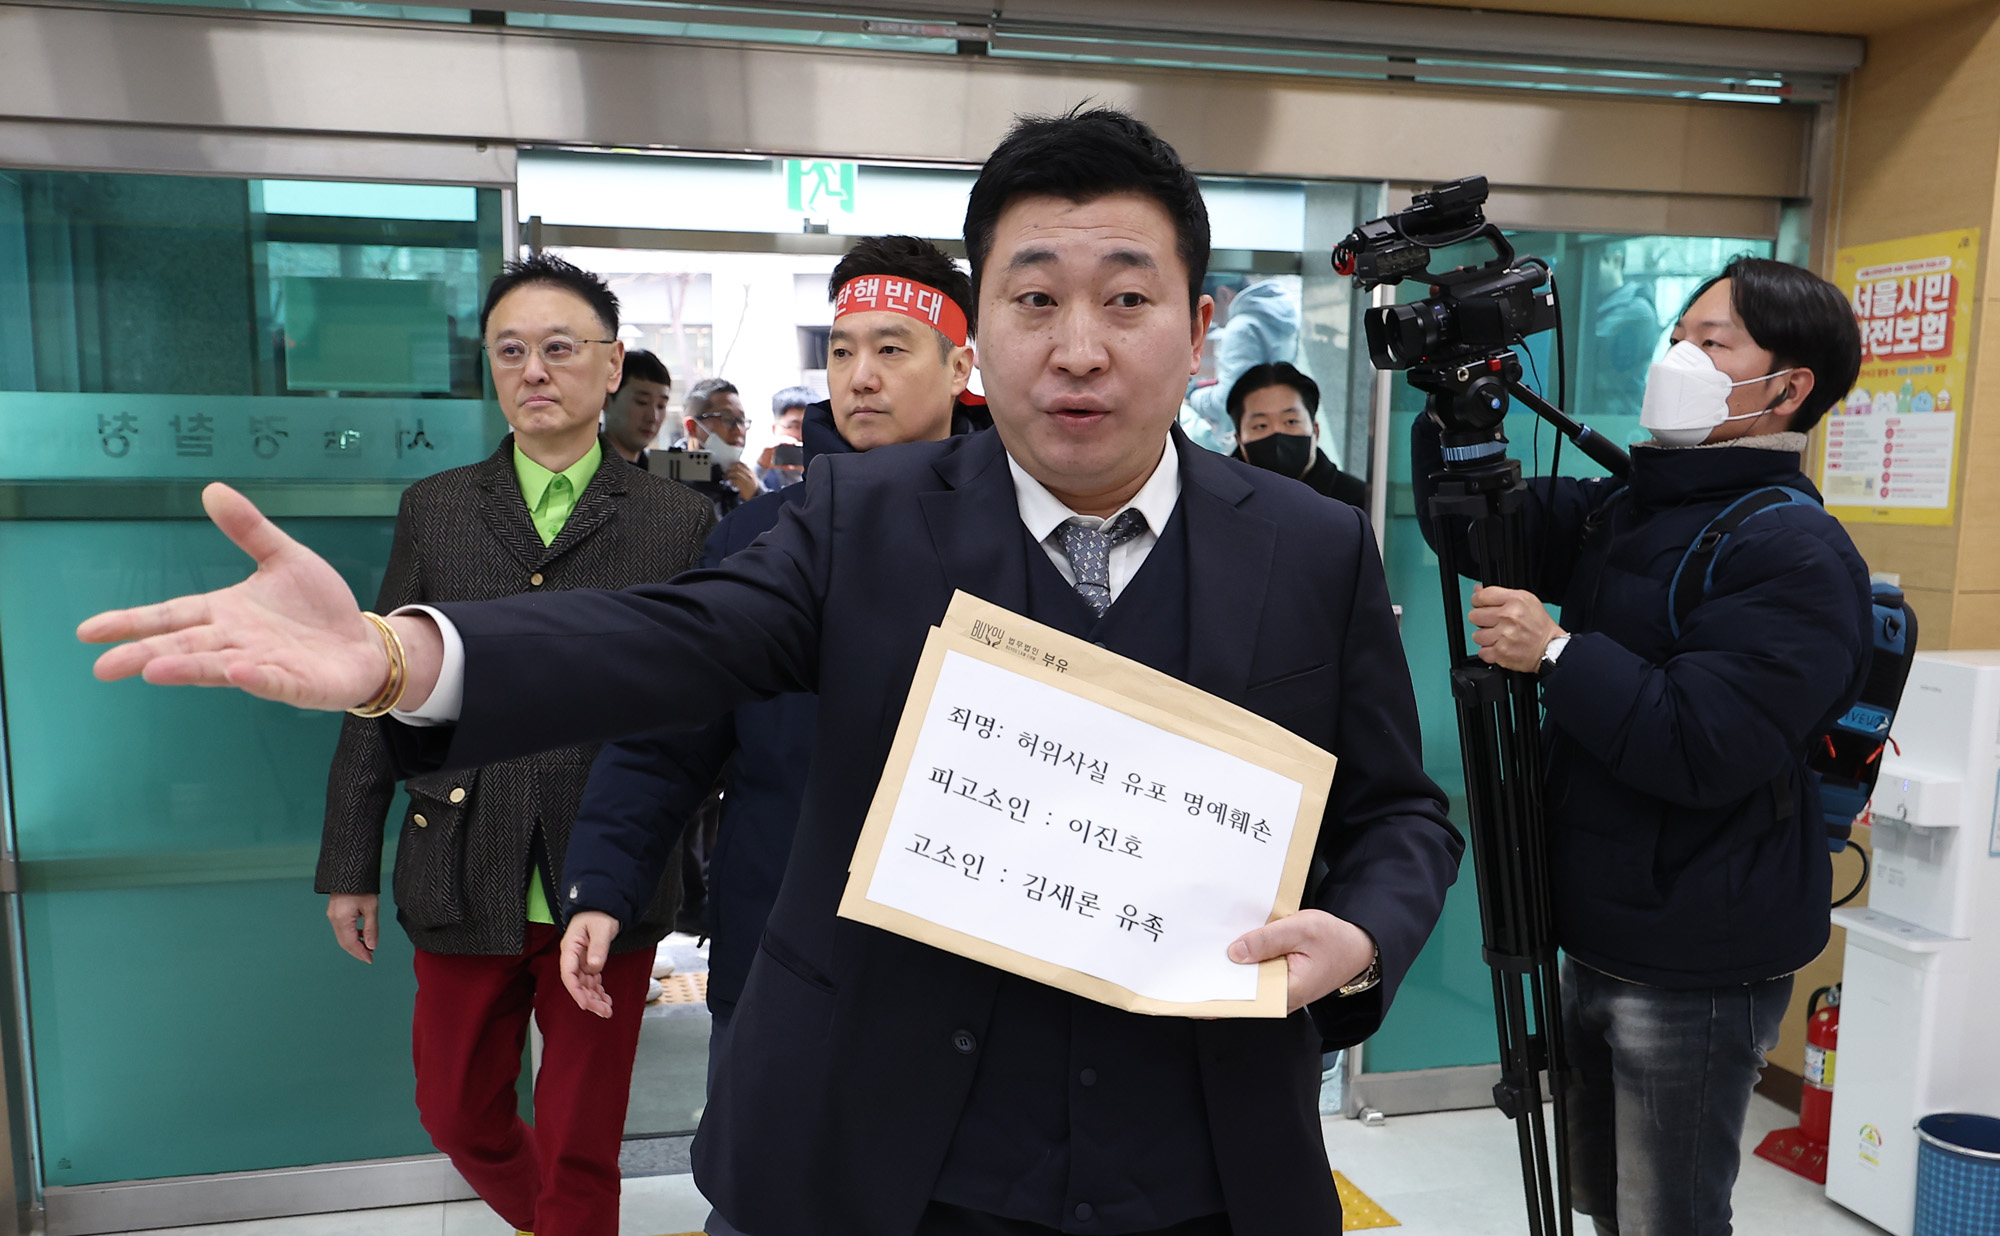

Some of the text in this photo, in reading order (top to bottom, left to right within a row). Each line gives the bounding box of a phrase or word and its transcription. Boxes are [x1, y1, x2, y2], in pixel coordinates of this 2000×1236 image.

[1851, 271, 1952, 318] 서울시민
[1042, 652, 1069, 673] 부유
[928, 766, 1030, 824] 피고소인
[1069, 818, 1143, 859] 이진호
[947, 706, 1272, 843] 죄명: 허위사실 유포 명예훼손
[905, 833, 985, 881] 고소인
[1023, 873, 1101, 918] 김새론
[1115, 904, 1164, 943] 유족
